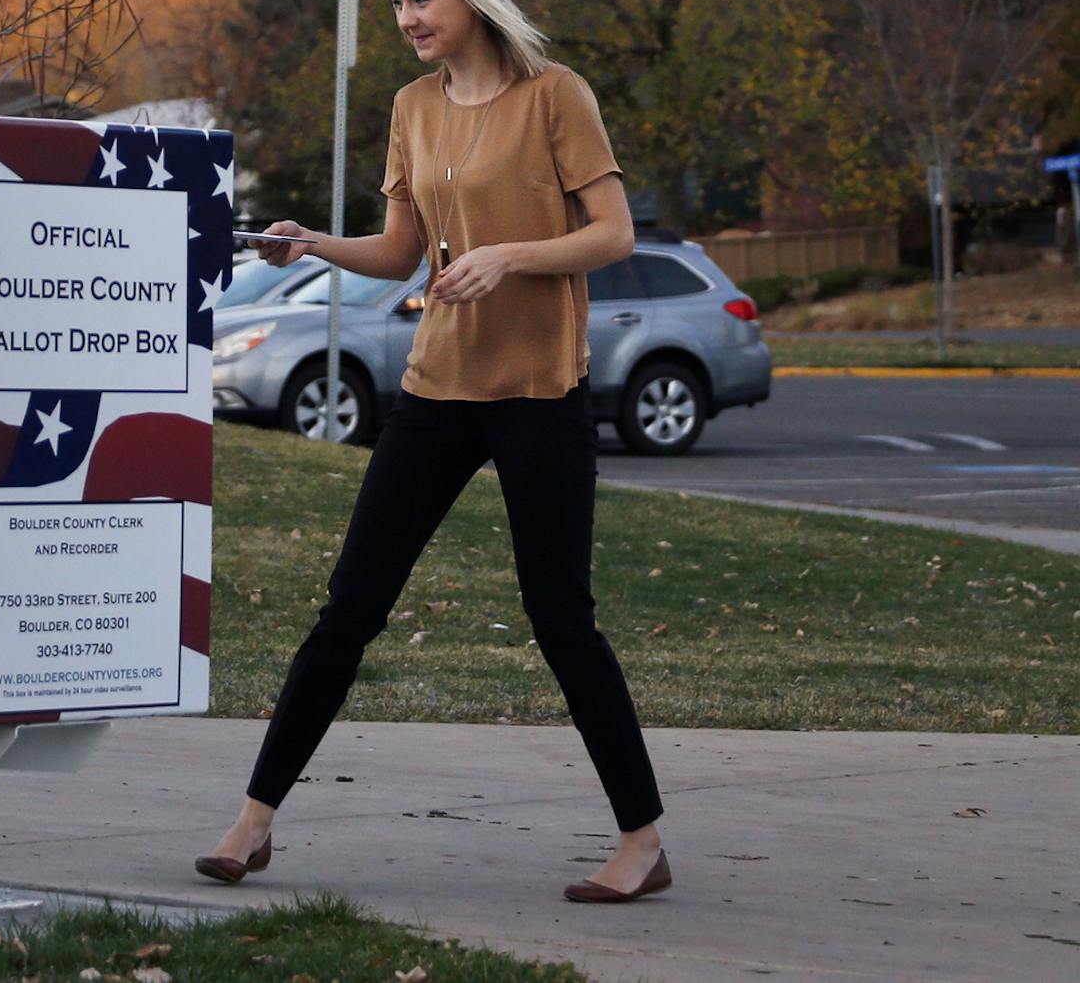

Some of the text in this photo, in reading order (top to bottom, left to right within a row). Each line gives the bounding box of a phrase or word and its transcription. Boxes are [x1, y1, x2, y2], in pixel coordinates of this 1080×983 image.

[31, 221, 130, 249] OFFICIAL
[91, 276, 177, 302] COUNTY
[70, 328, 129, 353] DROP
[136, 330, 178, 354] BOX
[9, 516, 143, 530] BOULDER COUNTY CLERK
[35, 542, 118, 555] AND RECORDER
[103, 592, 133, 605] SUITE
[136, 591, 157, 604] 200
[19, 617, 129, 633] BOULDER, CO 80301
[36, 643, 113, 658] 303-413-7740
